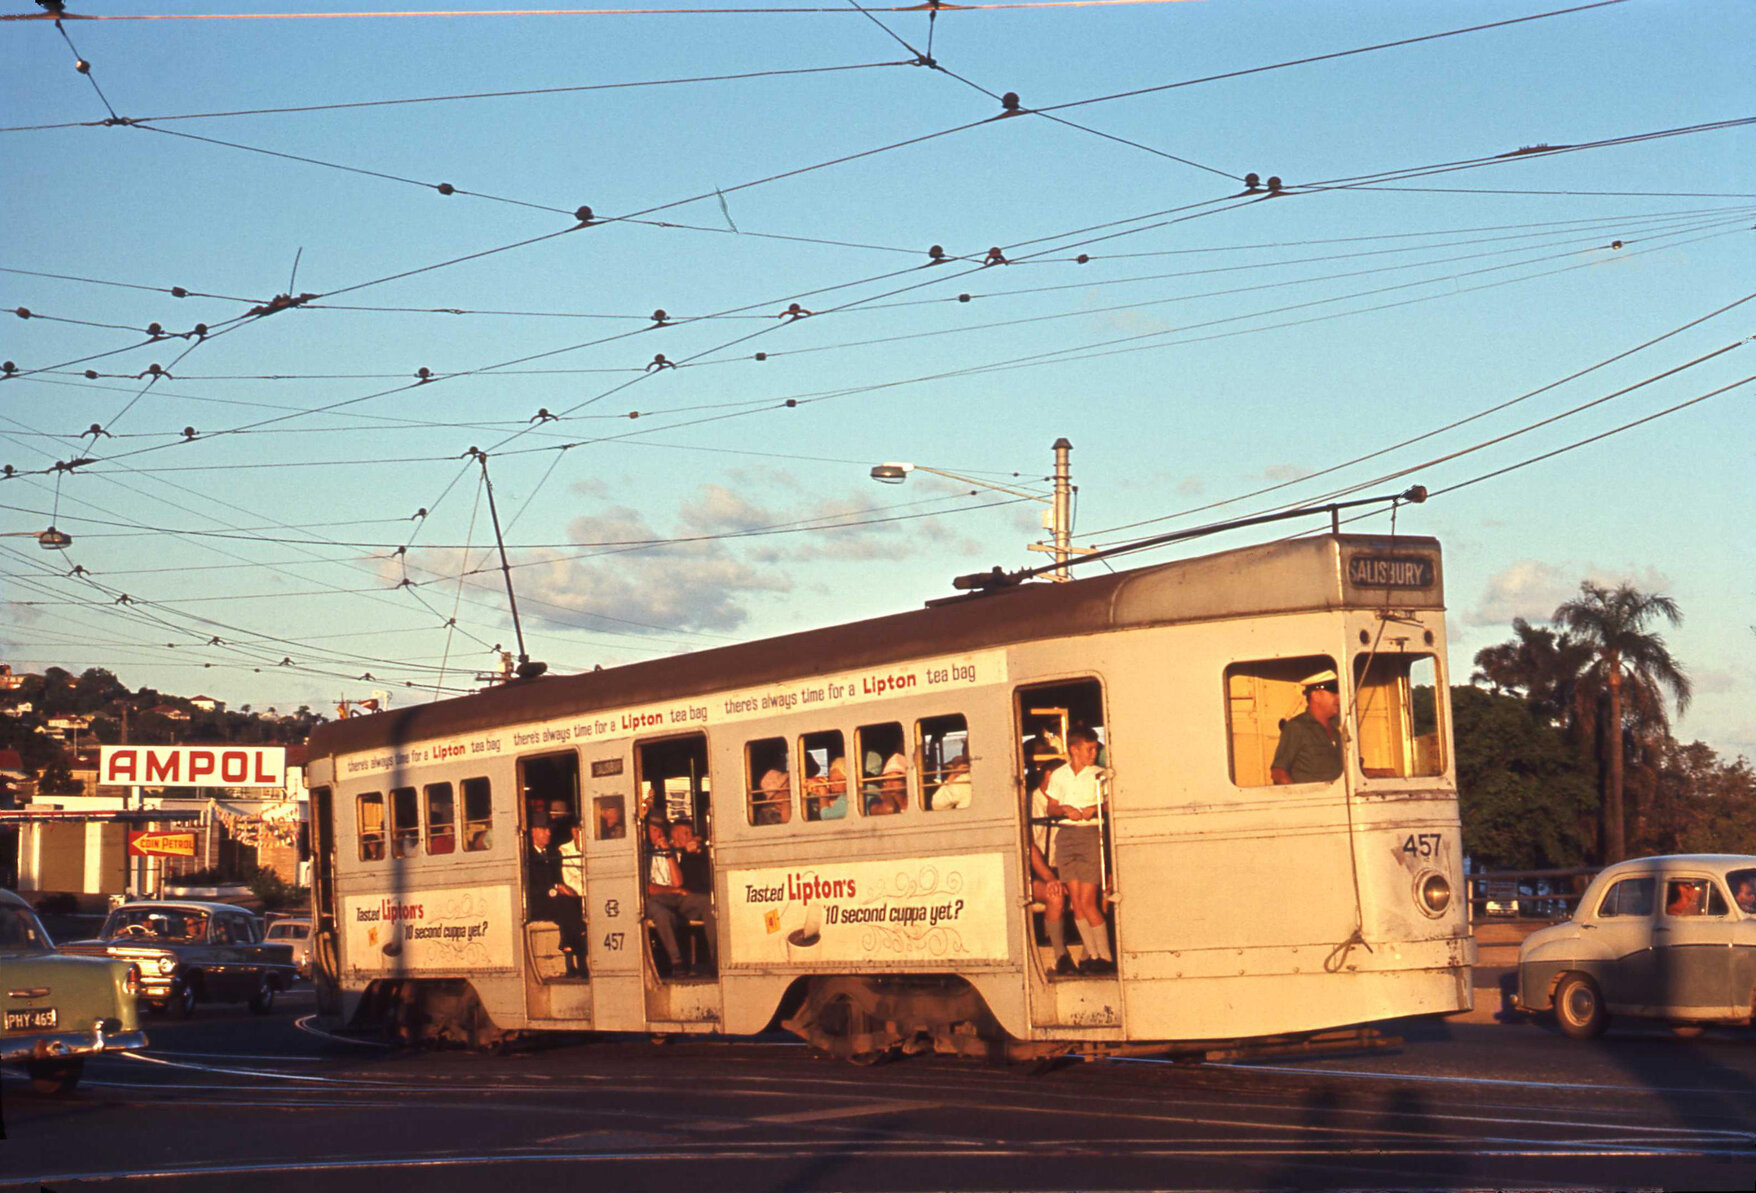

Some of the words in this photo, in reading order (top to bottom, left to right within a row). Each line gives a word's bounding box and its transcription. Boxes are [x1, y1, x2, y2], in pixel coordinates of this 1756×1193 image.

[1350, 559, 1424, 585] SALISBURY
[724, 697, 758, 714] there's
[761, 692, 797, 711] always
[801, 687, 825, 704] time
[828, 683, 844, 700] for
[848, 683, 855, 696] a
[863, 674, 917, 695] Lipton
[926, 668, 948, 685] tea
[952, 664, 976, 682] bag
[514, 731, 540, 746] there's
[543, 727, 571, 743] always
[573, 723, 592, 737] time
[594, 720, 607, 734] for
[610, 721, 616, 732] a
[621, 712, 663, 731] Lipton
[670, 709, 687, 723] tea
[689, 705, 707, 721] bag
[108, 750, 276, 783] AMPOL
[370, 756, 394, 769] always
[411, 750, 422, 761] for
[424, 750, 429, 760] a
[432, 743, 466, 760] Lipton
[470, 741, 485, 753] tea
[486, 738, 501, 752] bag
[139, 839, 159, 849] COIN
[162, 837, 194, 850] PETROL
[1403, 833, 1441, 857] 457
[745, 884, 784, 903] Tasted
[787, 873, 856, 906] Lipton's
[356, 907, 380, 922] Tasted
[382, 899, 424, 924] Lipton's
[841, 903, 887, 923] second
[889, 906, 926, 926] cuppa
[930, 900, 964, 925] yet?
[414, 923, 442, 939] second
[443, 925, 466, 942] cuppa
[468, 921, 488, 941] yet?
[604, 932, 625, 951] 457
